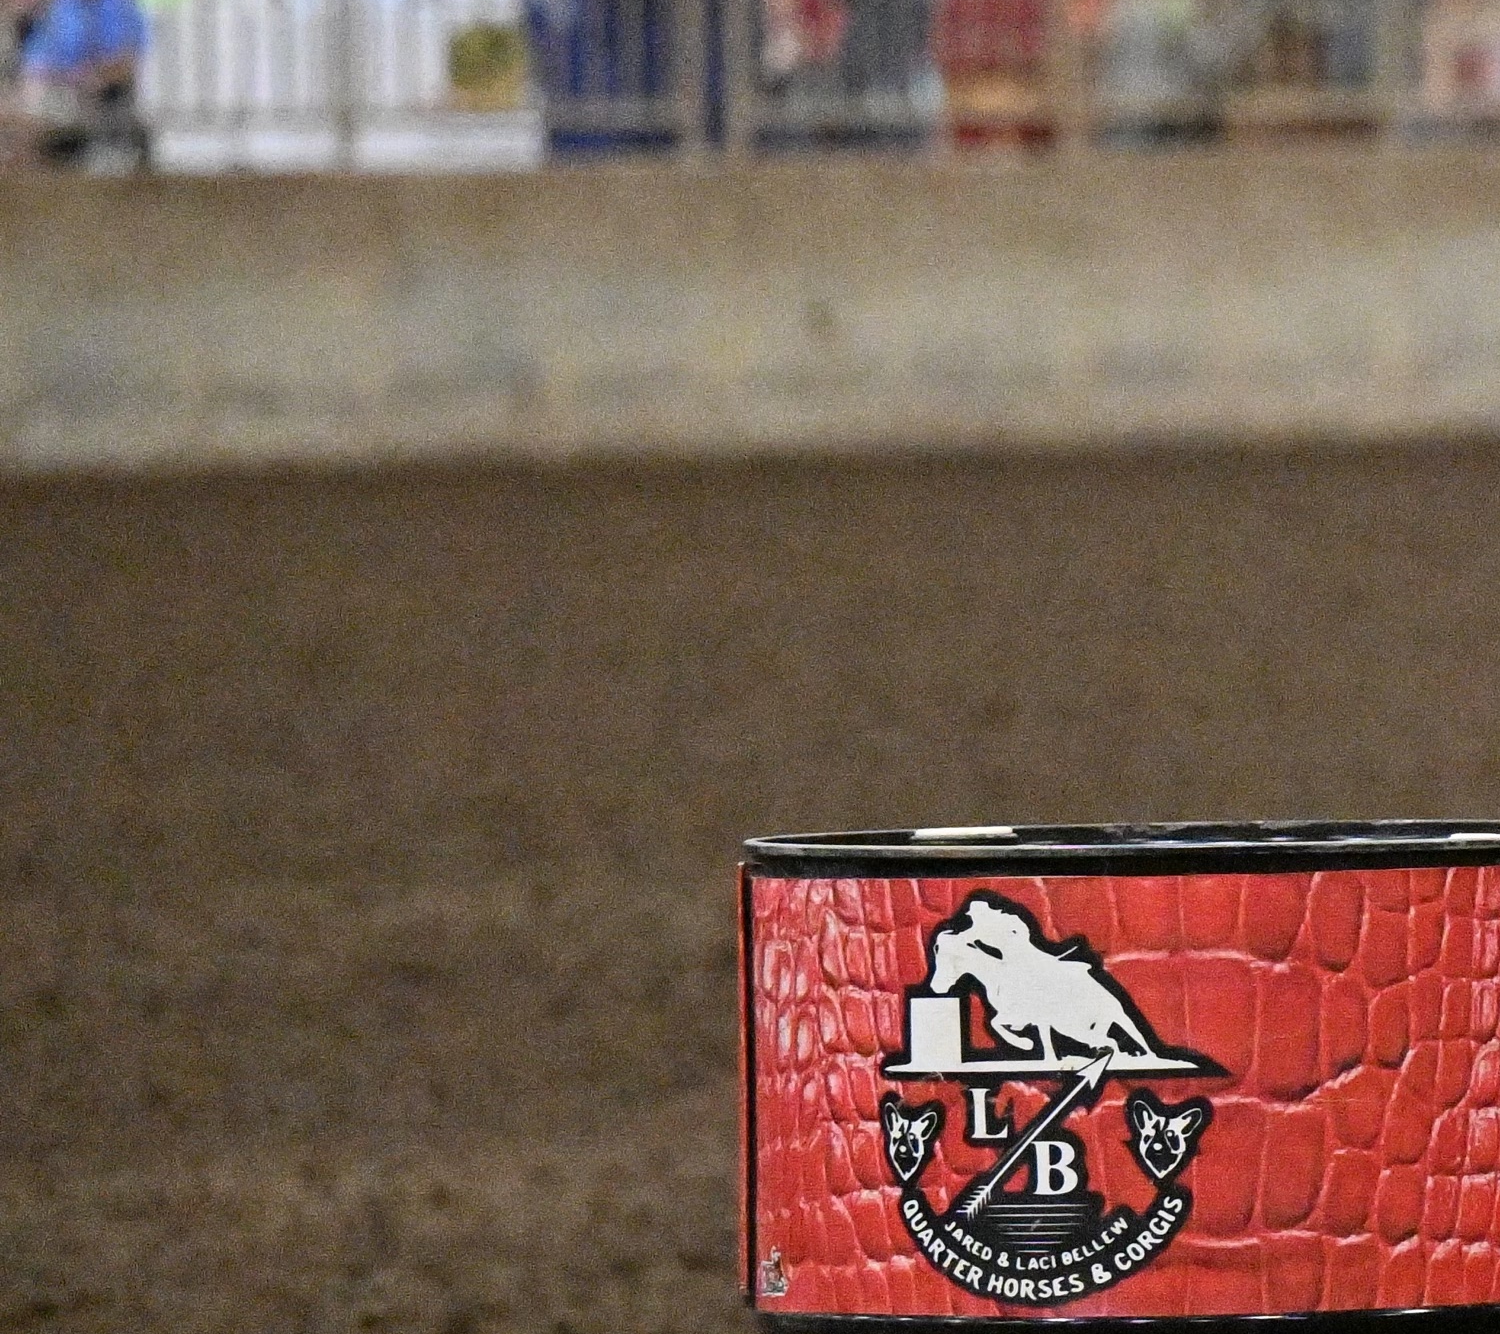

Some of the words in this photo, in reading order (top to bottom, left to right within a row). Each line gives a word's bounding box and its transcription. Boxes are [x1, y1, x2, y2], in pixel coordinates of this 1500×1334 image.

[968, 1088, 1008, 1139] L
[1031, 1141, 1080, 1195] B
[903, 1199, 984, 1291] QUARTER
[987, 1273, 1085, 1301] HORSES
[1090, 1263, 1113, 1284] &
[1114, 1196, 1183, 1271] CORGIS
[944, 1221, 993, 1261] JARED
[997, 1251, 1010, 1268] &
[1016, 1254, 1057, 1271] LACI
[1061, 1217, 1129, 1266] BELLEW
